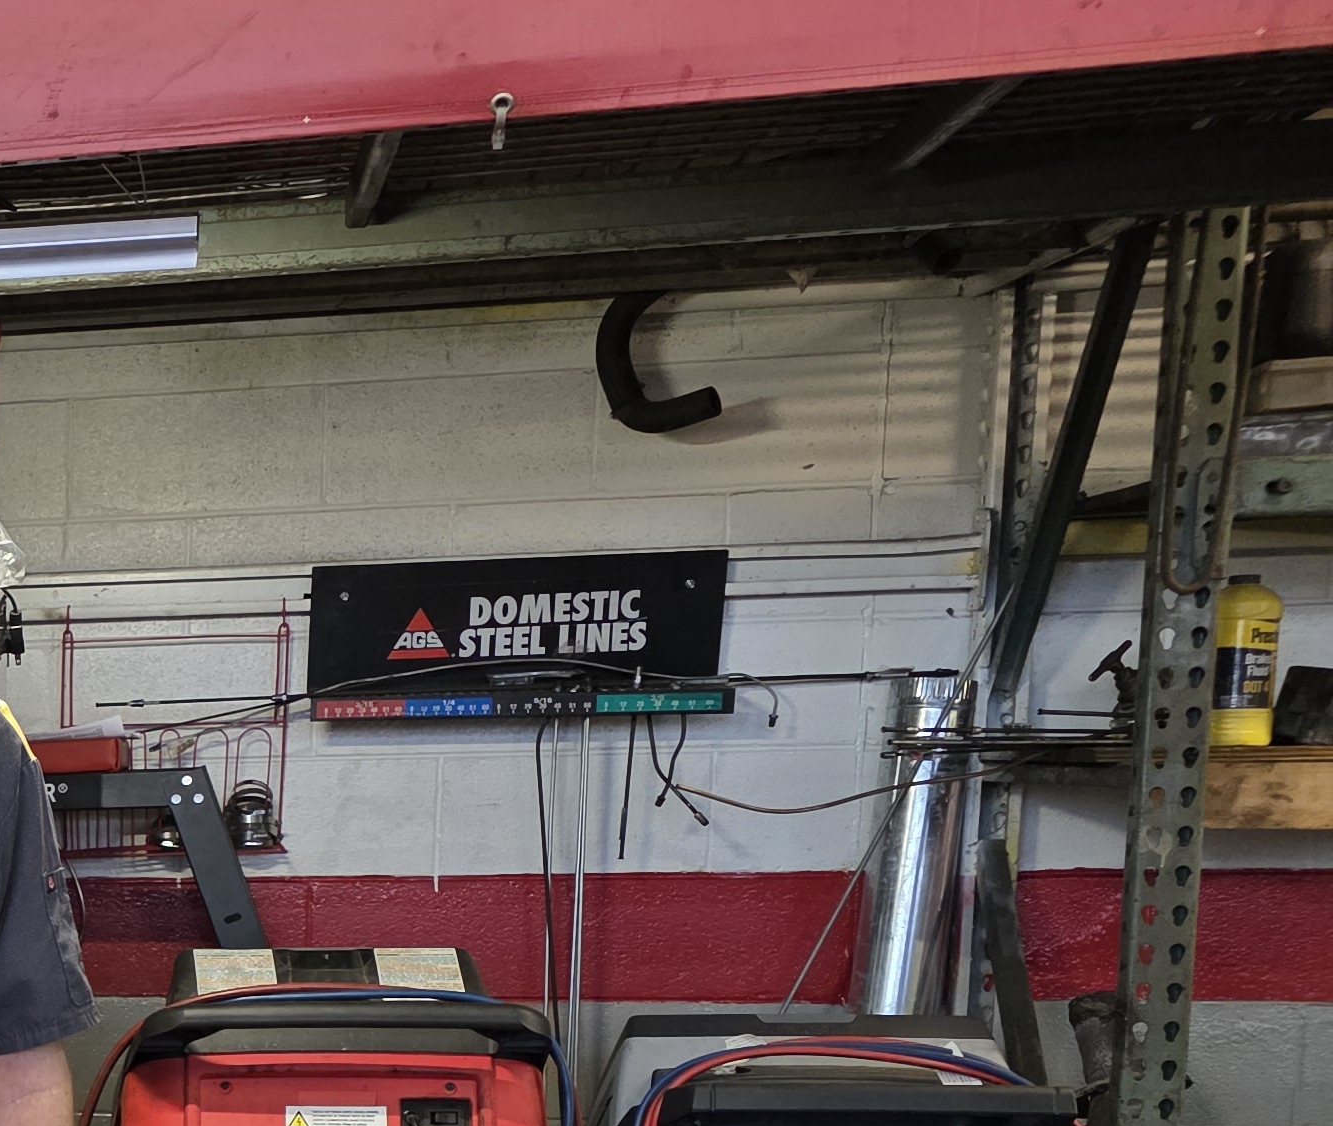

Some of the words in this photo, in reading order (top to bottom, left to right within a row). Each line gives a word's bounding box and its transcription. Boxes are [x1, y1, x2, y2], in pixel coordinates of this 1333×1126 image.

[469, 589, 641, 626] DOMESTIC
[393, 631, 444, 649] AGS
[458, 625, 546, 658] STEEL
[558, 621, 647, 654] LINES
